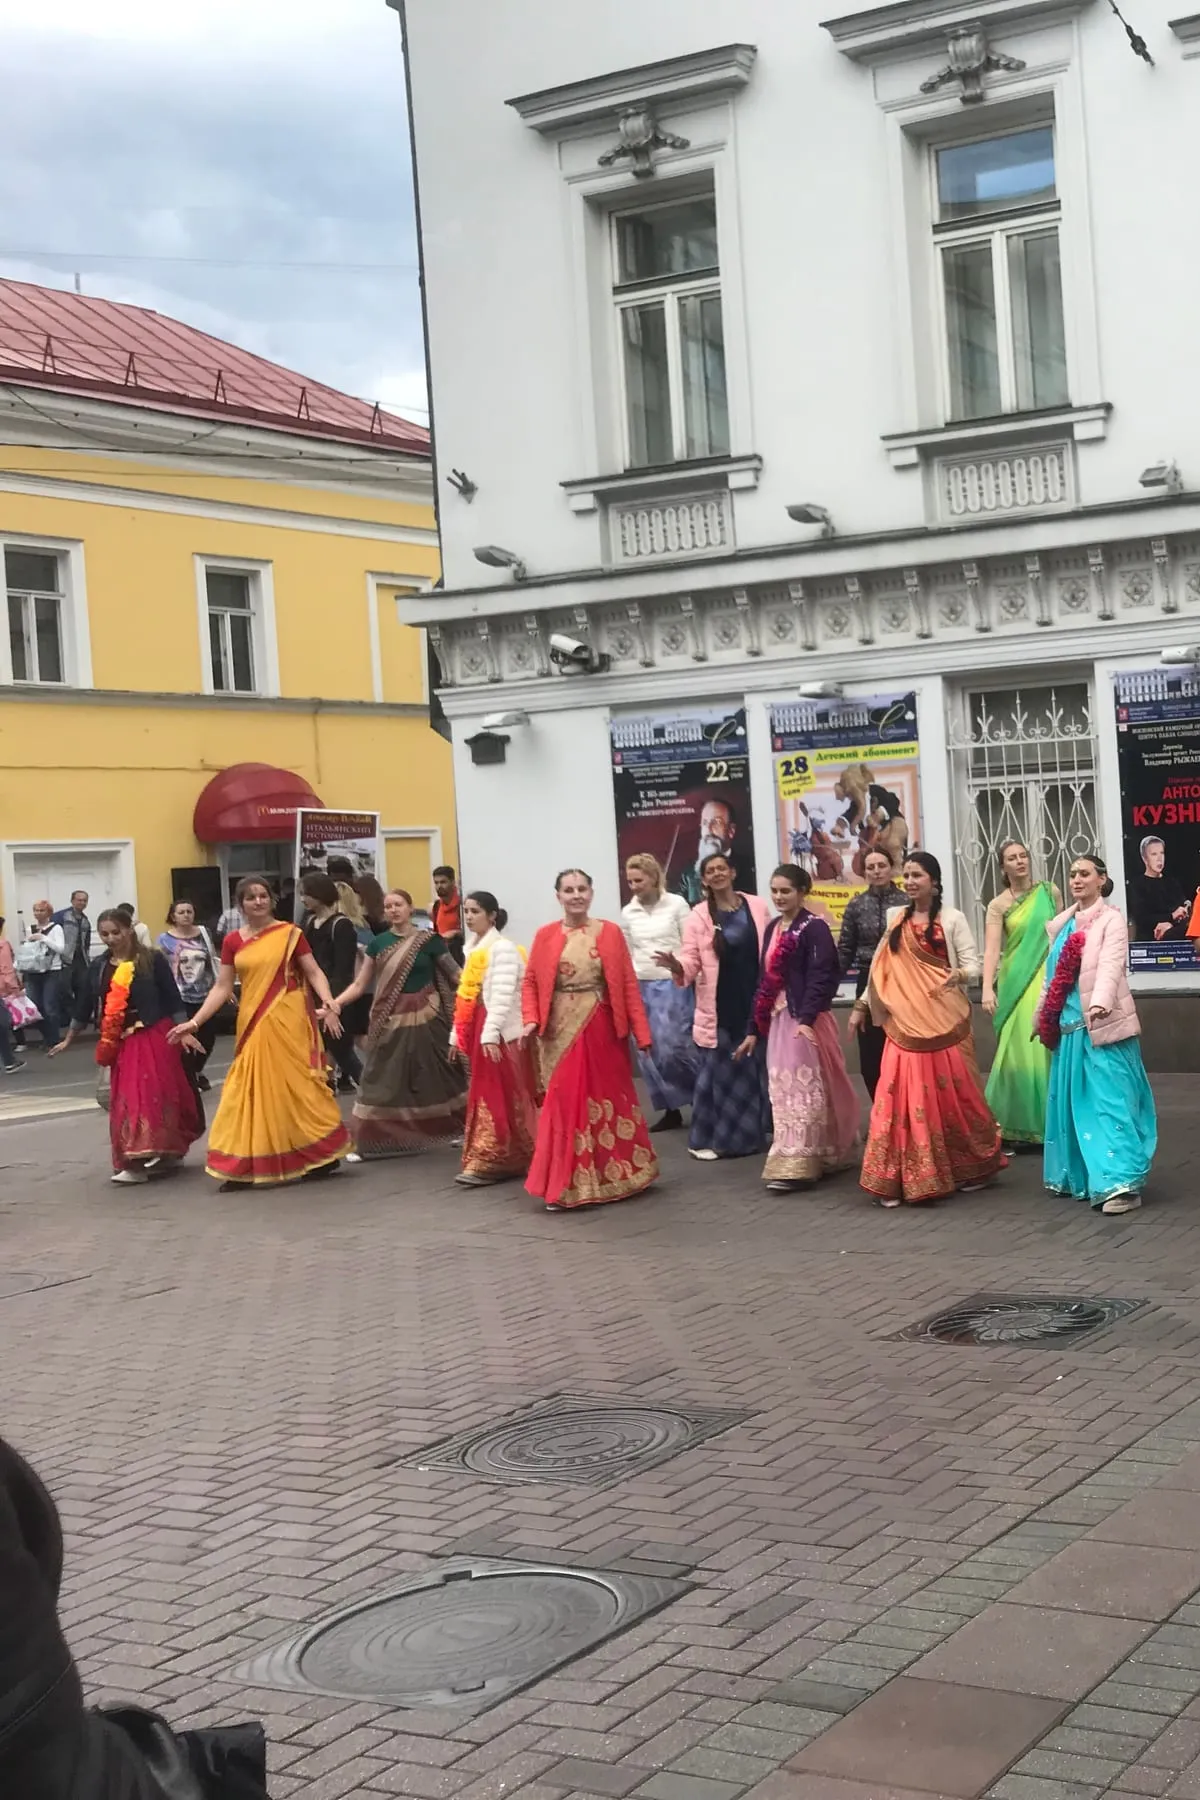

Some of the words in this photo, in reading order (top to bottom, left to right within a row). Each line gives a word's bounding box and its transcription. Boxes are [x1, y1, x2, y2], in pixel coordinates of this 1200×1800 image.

[815, 750, 858, 762] Детский
[863, 746, 915, 758] абонемент
[706, 761, 729, 782] 22
[780, 756, 809, 777] 28
